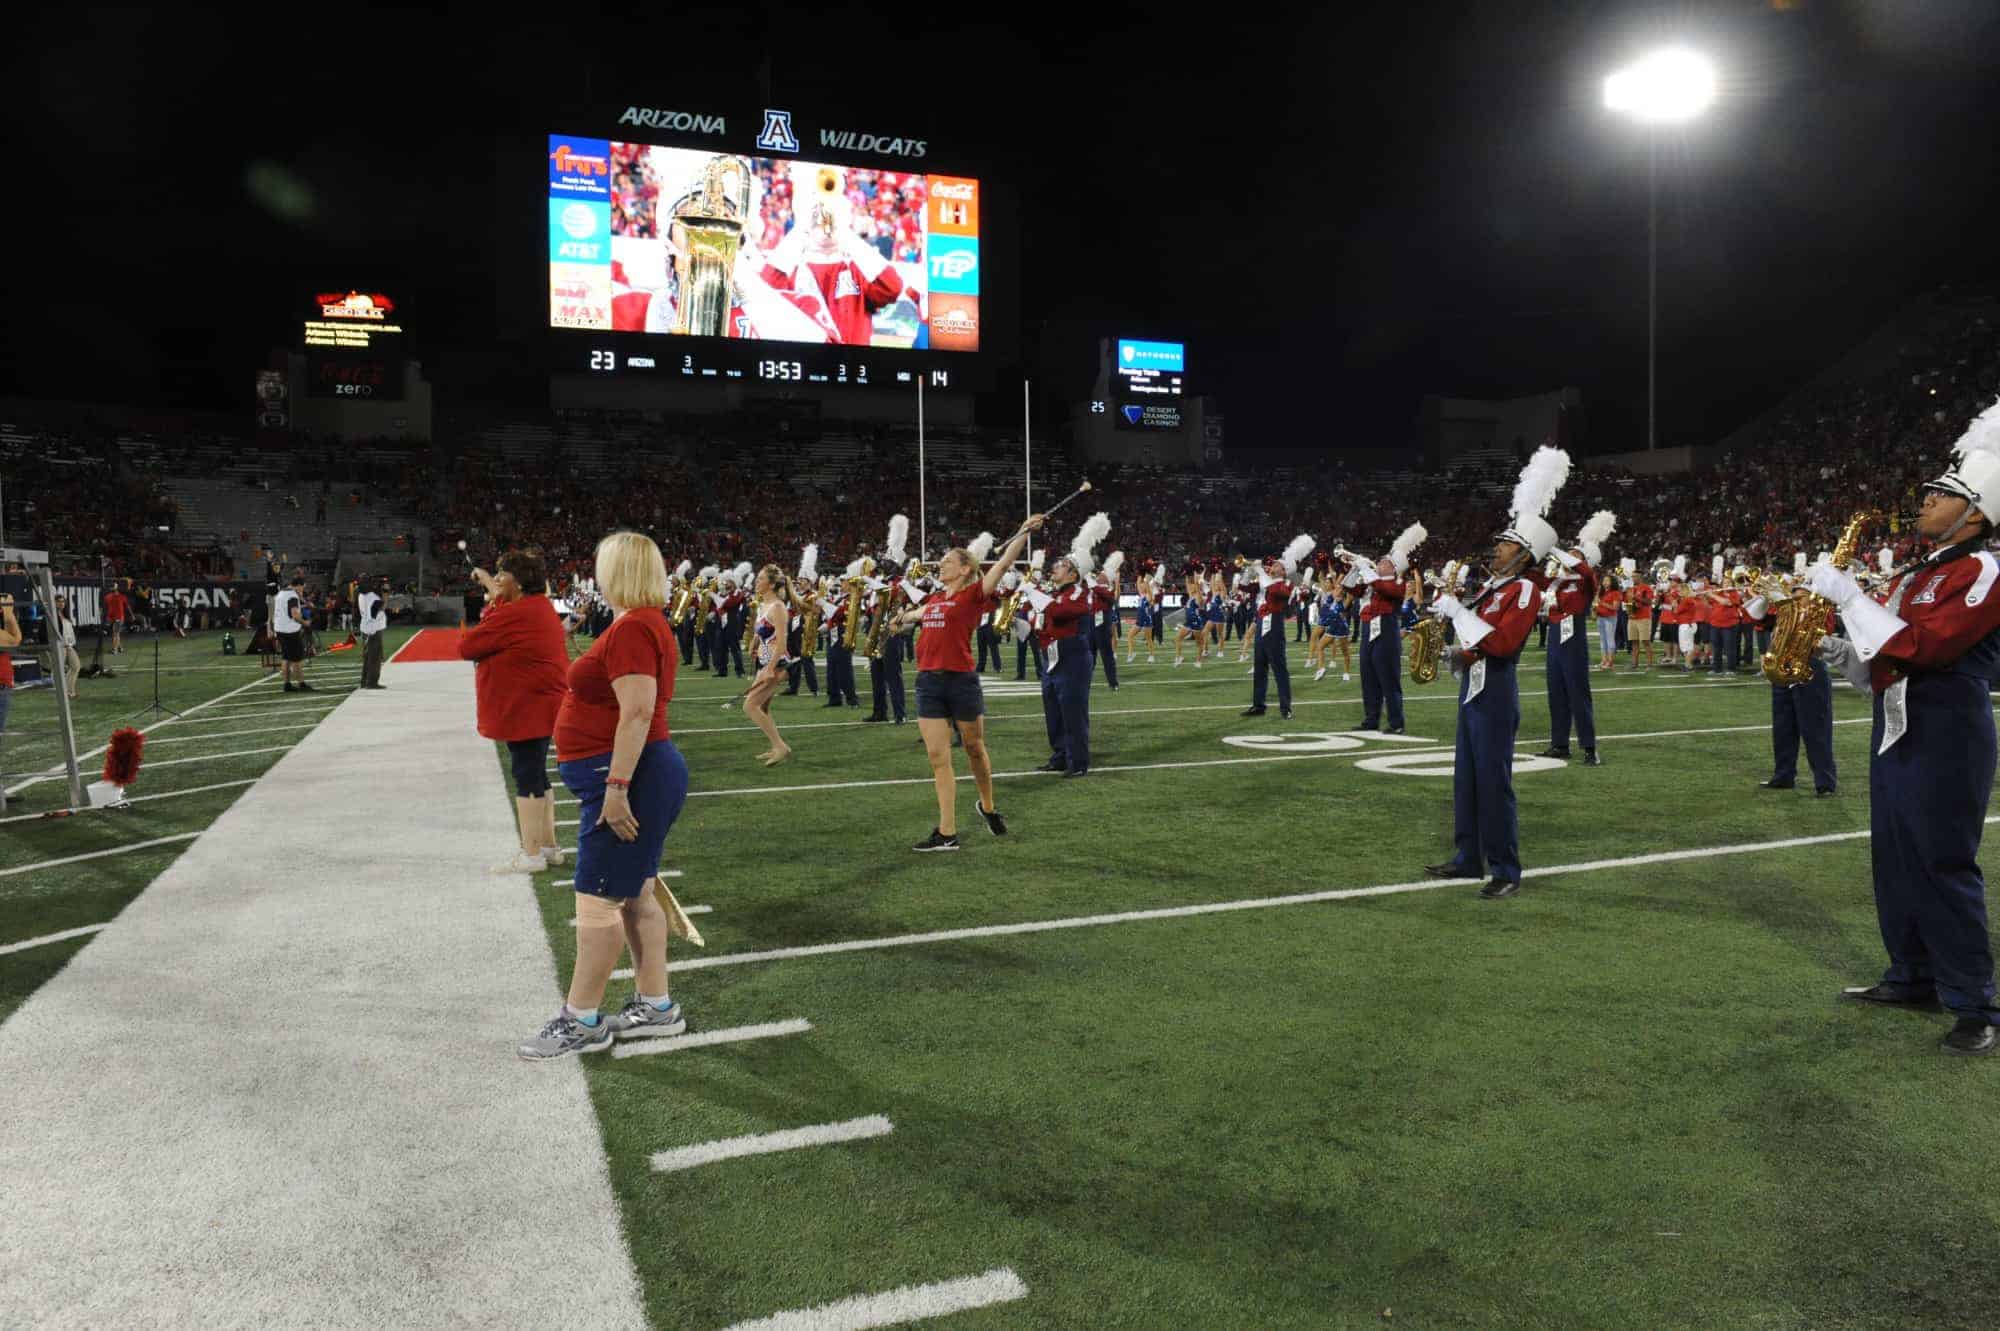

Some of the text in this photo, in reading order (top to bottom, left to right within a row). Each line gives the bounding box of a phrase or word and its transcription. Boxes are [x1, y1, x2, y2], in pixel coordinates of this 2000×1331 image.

[619, 106, 727, 135] ARIZONA
[757, 108, 799, 152] A
[820, 128, 928, 158] WILDCATS
[931, 249, 977, 280] TEP
[590, 350, 615, 370] 23
[684, 355, 692, 368] 3
[759, 360, 801, 381] 13:53
[839, 364, 847, 376] 3
[859, 365, 867, 377] 3
[932, 370, 948, 387] 14
[335, 384, 373, 394] zero
[1091, 401, 1105, 413] 25
[1142, 413, 1180, 421] DIAMOND
